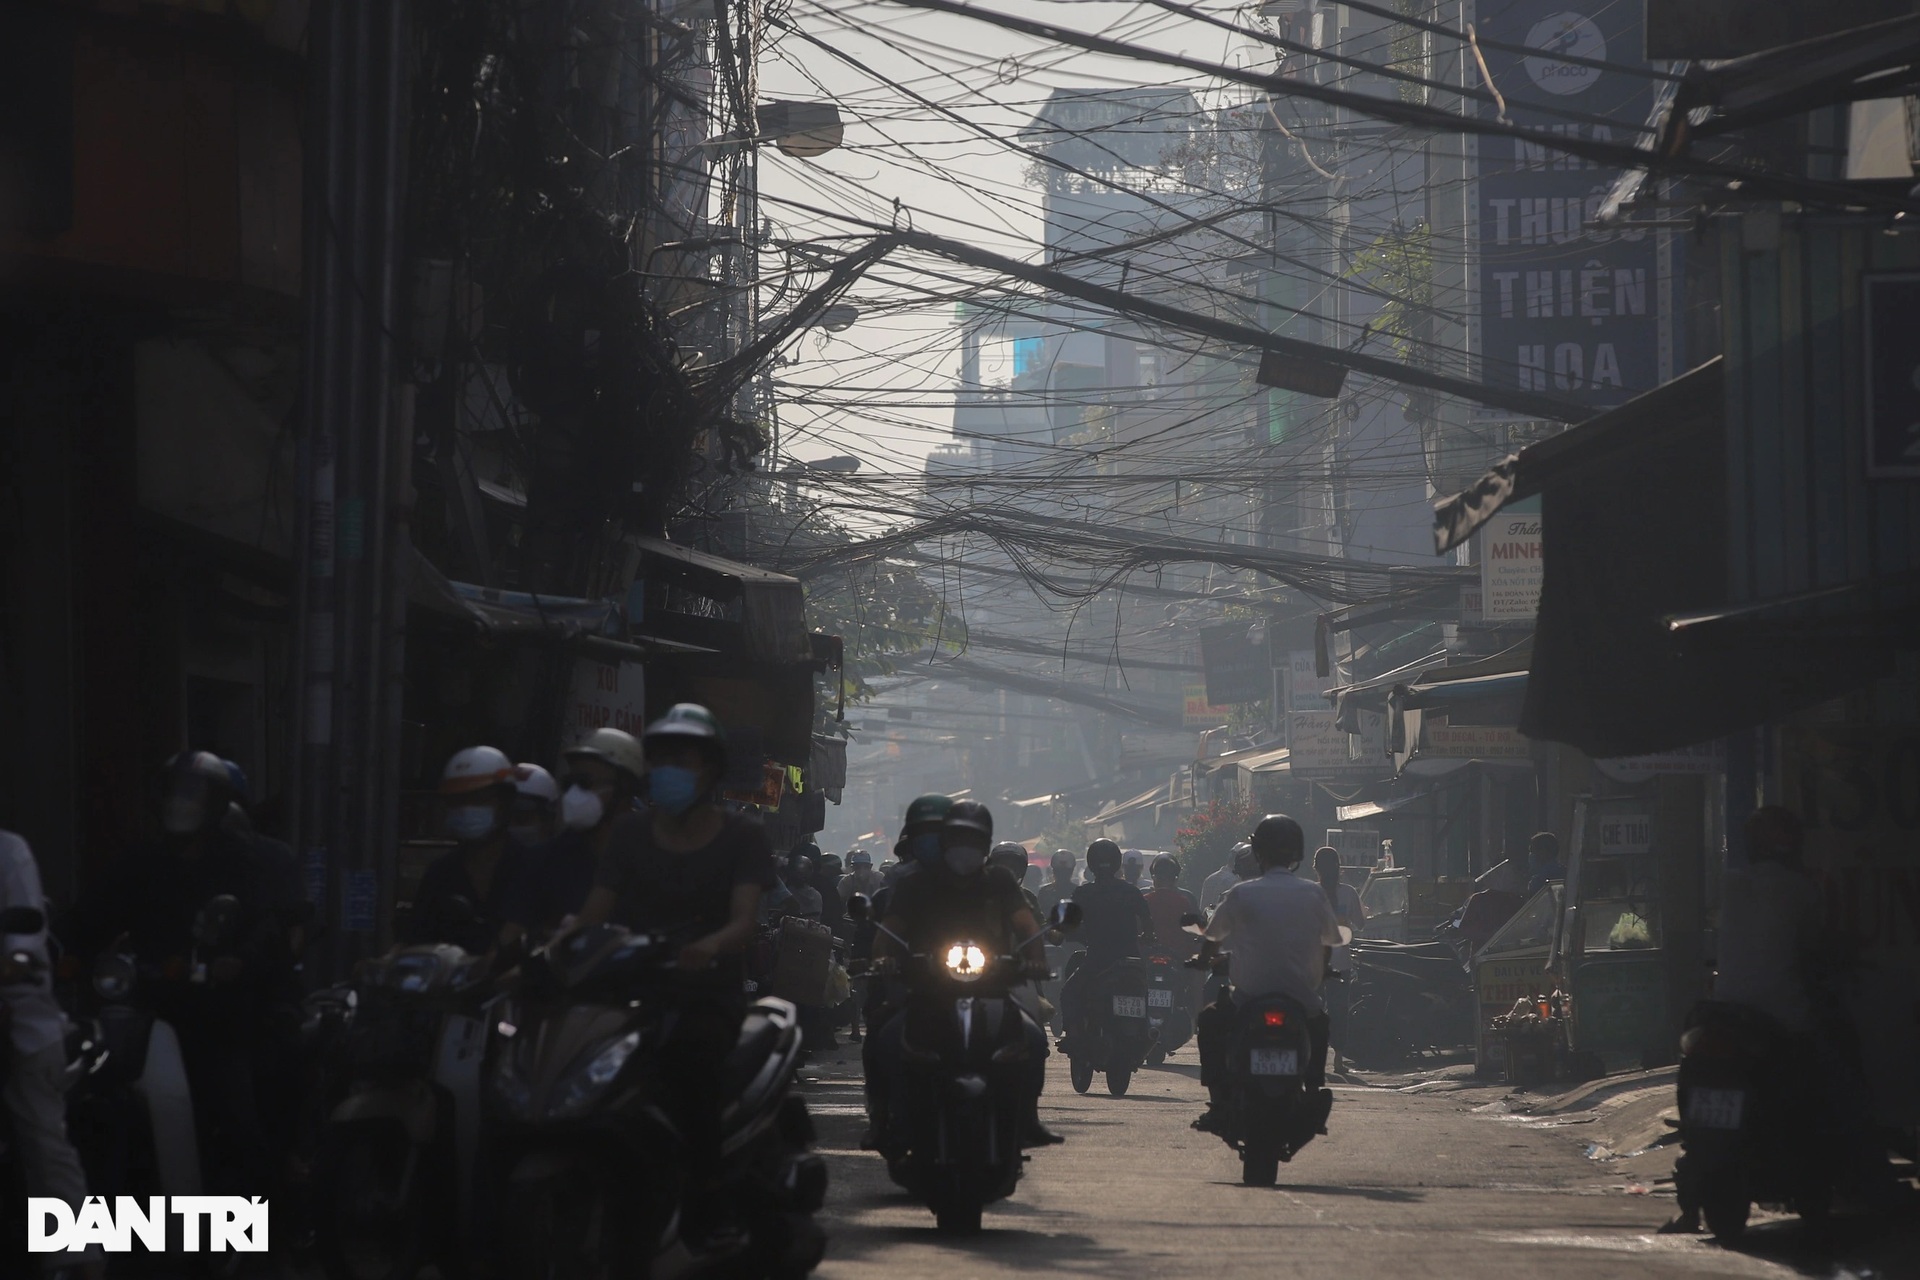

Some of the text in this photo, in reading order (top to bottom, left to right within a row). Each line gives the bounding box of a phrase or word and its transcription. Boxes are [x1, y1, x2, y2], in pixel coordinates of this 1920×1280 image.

[1493, 259, 1647, 326] THIỆN
[1518, 342, 1623, 393] HOA
[1491, 542, 1543, 560] MINH
